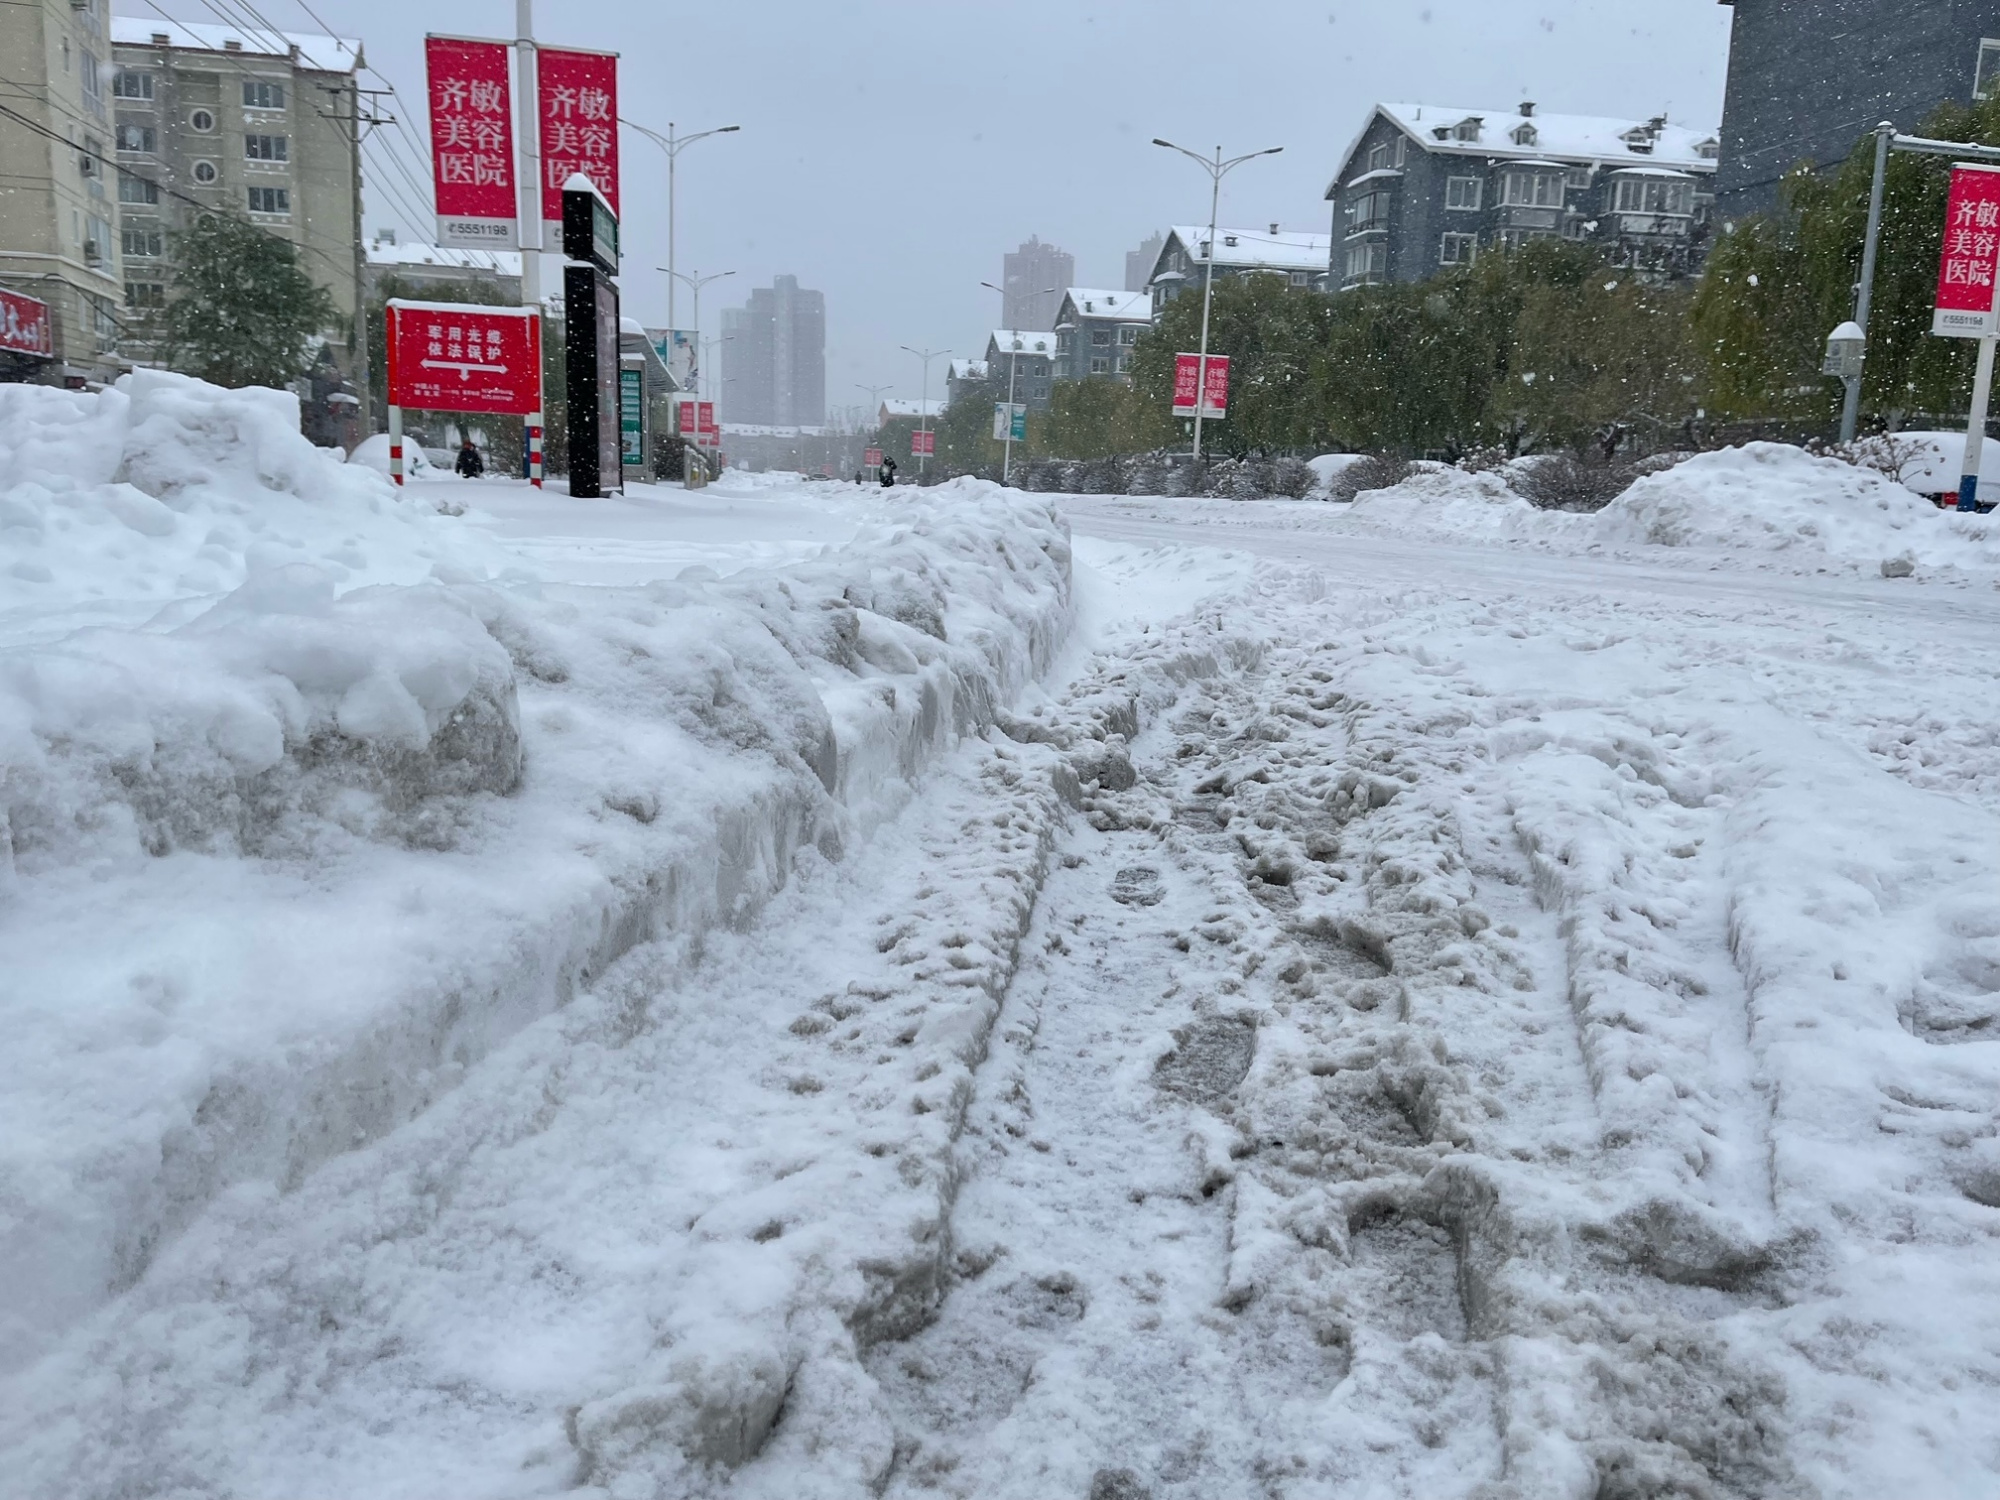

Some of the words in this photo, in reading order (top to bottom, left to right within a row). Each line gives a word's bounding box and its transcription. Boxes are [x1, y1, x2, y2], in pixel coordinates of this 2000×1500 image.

[434, 76, 503, 113] 齐敏
[546, 84, 612, 121] 齐敏
[435, 113, 505, 151] 美容
[547, 121, 612, 157] 美容
[439, 151, 508, 187] 医院
[1953, 198, 1999, 228] 齐敏
[457, 222, 508, 236] 5551198
[1949, 229, 1997, 258] 美容
[1945, 258, 1992, 287] 医院
[427, 324, 502, 345] 军用光缆
[1949, 315, 1983, 326] 5551198
[427, 341, 502, 360] 依法保护
